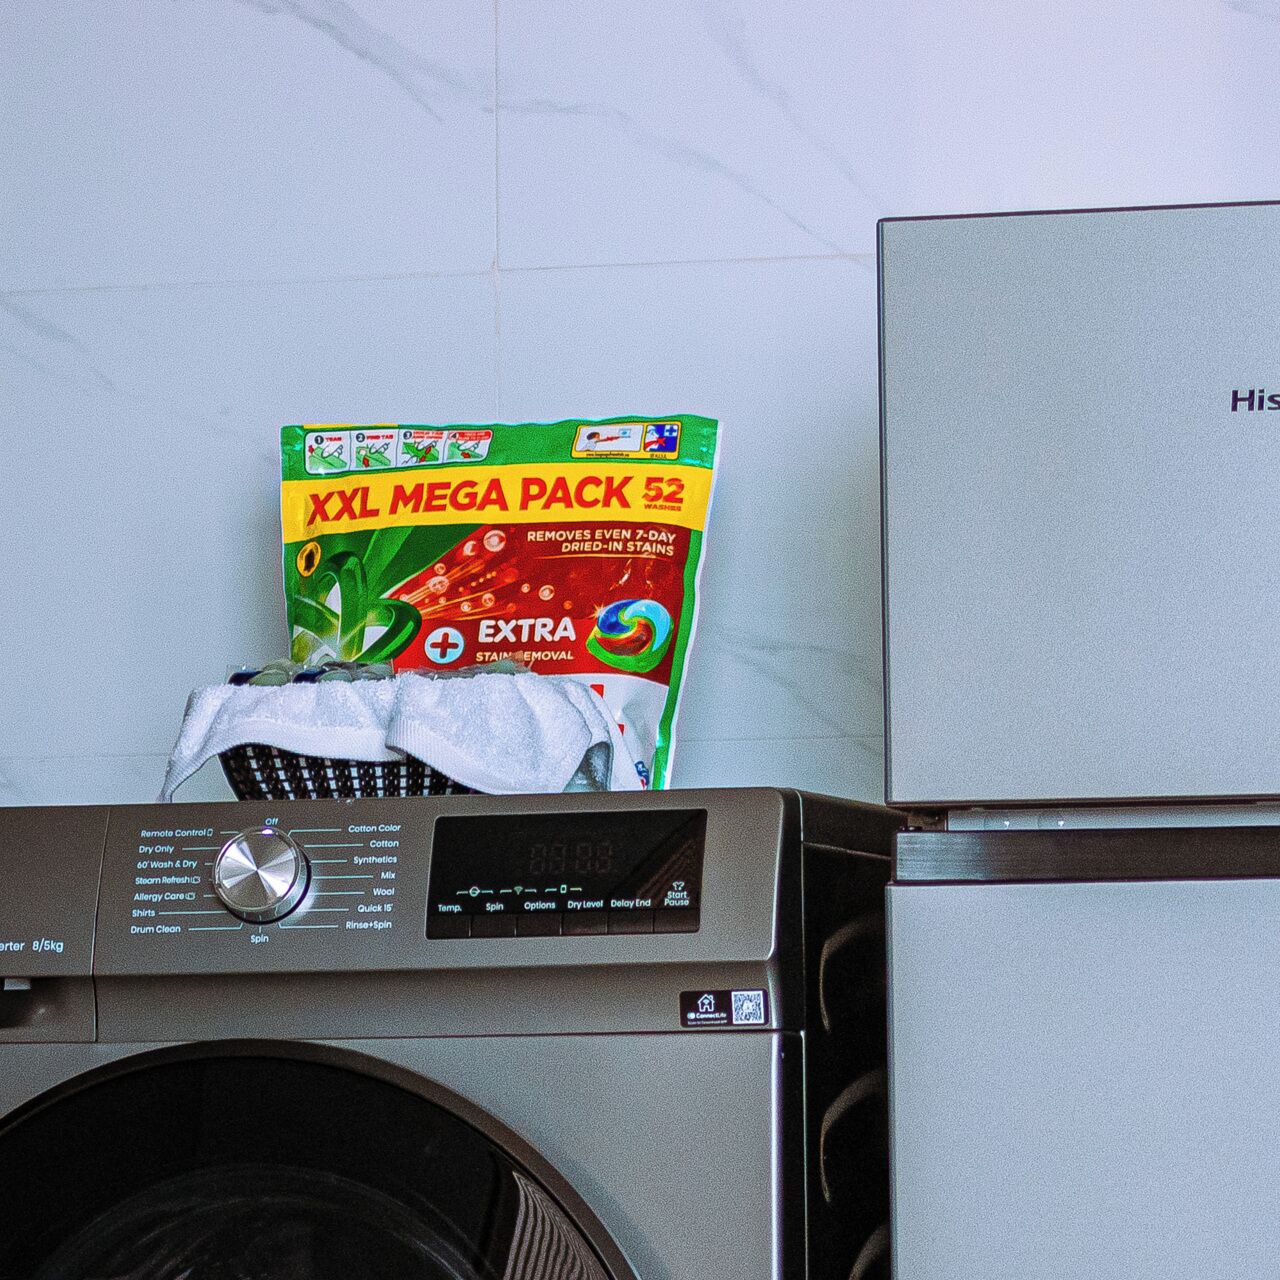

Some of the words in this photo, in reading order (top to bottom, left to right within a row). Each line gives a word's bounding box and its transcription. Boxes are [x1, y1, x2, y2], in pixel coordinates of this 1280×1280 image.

[307, 486, 380, 526] XXL
[388, 478, 509, 515] MEGA
[519, 475, 634, 511] PACK
[642, 477, 685, 504] 52
[527, 530, 591, 542] REMOVES
[595, 529, 631, 540] EVEN
[635, 529, 676, 544] 7-DAY
[561, 541, 623, 553] DRIED-IN
[626, 541, 674, 556] STAINS
[478, 616, 577, 643] EXTRA
[519, 650, 574, 661] EMOVAL
[265, 817, 279, 826] Off
[141, 829, 178, 838] Remote
[179, 828, 206, 837] Control
[348, 825, 377, 833] Cotton
[378, 824, 401, 832] Color
[369, 840, 400, 848] Cotton
[139, 845, 153, 854] Dry
[154, 845, 174, 854] Only
[150, 860, 174, 869] Wash
[175, 860, 182, 868] &
[183, 860, 197, 869] Dry
[353, 855, 397, 865] Synthetics
[380, 871, 396, 879] Mix
[135, 877, 161, 885] Steam
[162, 876, 189, 884] Refresh
[373, 887, 395, 896] Wool
[667, 891, 687, 899] Start
[133, 893, 162, 903] Allergy
[164, 892, 185, 900] Care
[664, 898, 690, 907] Pause
[357, 903, 382, 913] Quick
[437, 904, 462, 913] Temp.
[485, 902, 504, 912] Spin
[524, 901, 556, 911] Options
[567, 900, 581, 910] Dry
[583, 900, 603, 908] Level
[610, 899, 634, 909] Delay
[635, 898, 651, 907] End
[132, 909, 155, 917] Shirts
[131, 926, 154, 934] Drum
[156, 925, 181, 933] Clean
[345, 920, 392, 930] Rinse+Spin
[250, 934, 269, 944] Spin
[32, 938, 64, 953] 8/5kg
